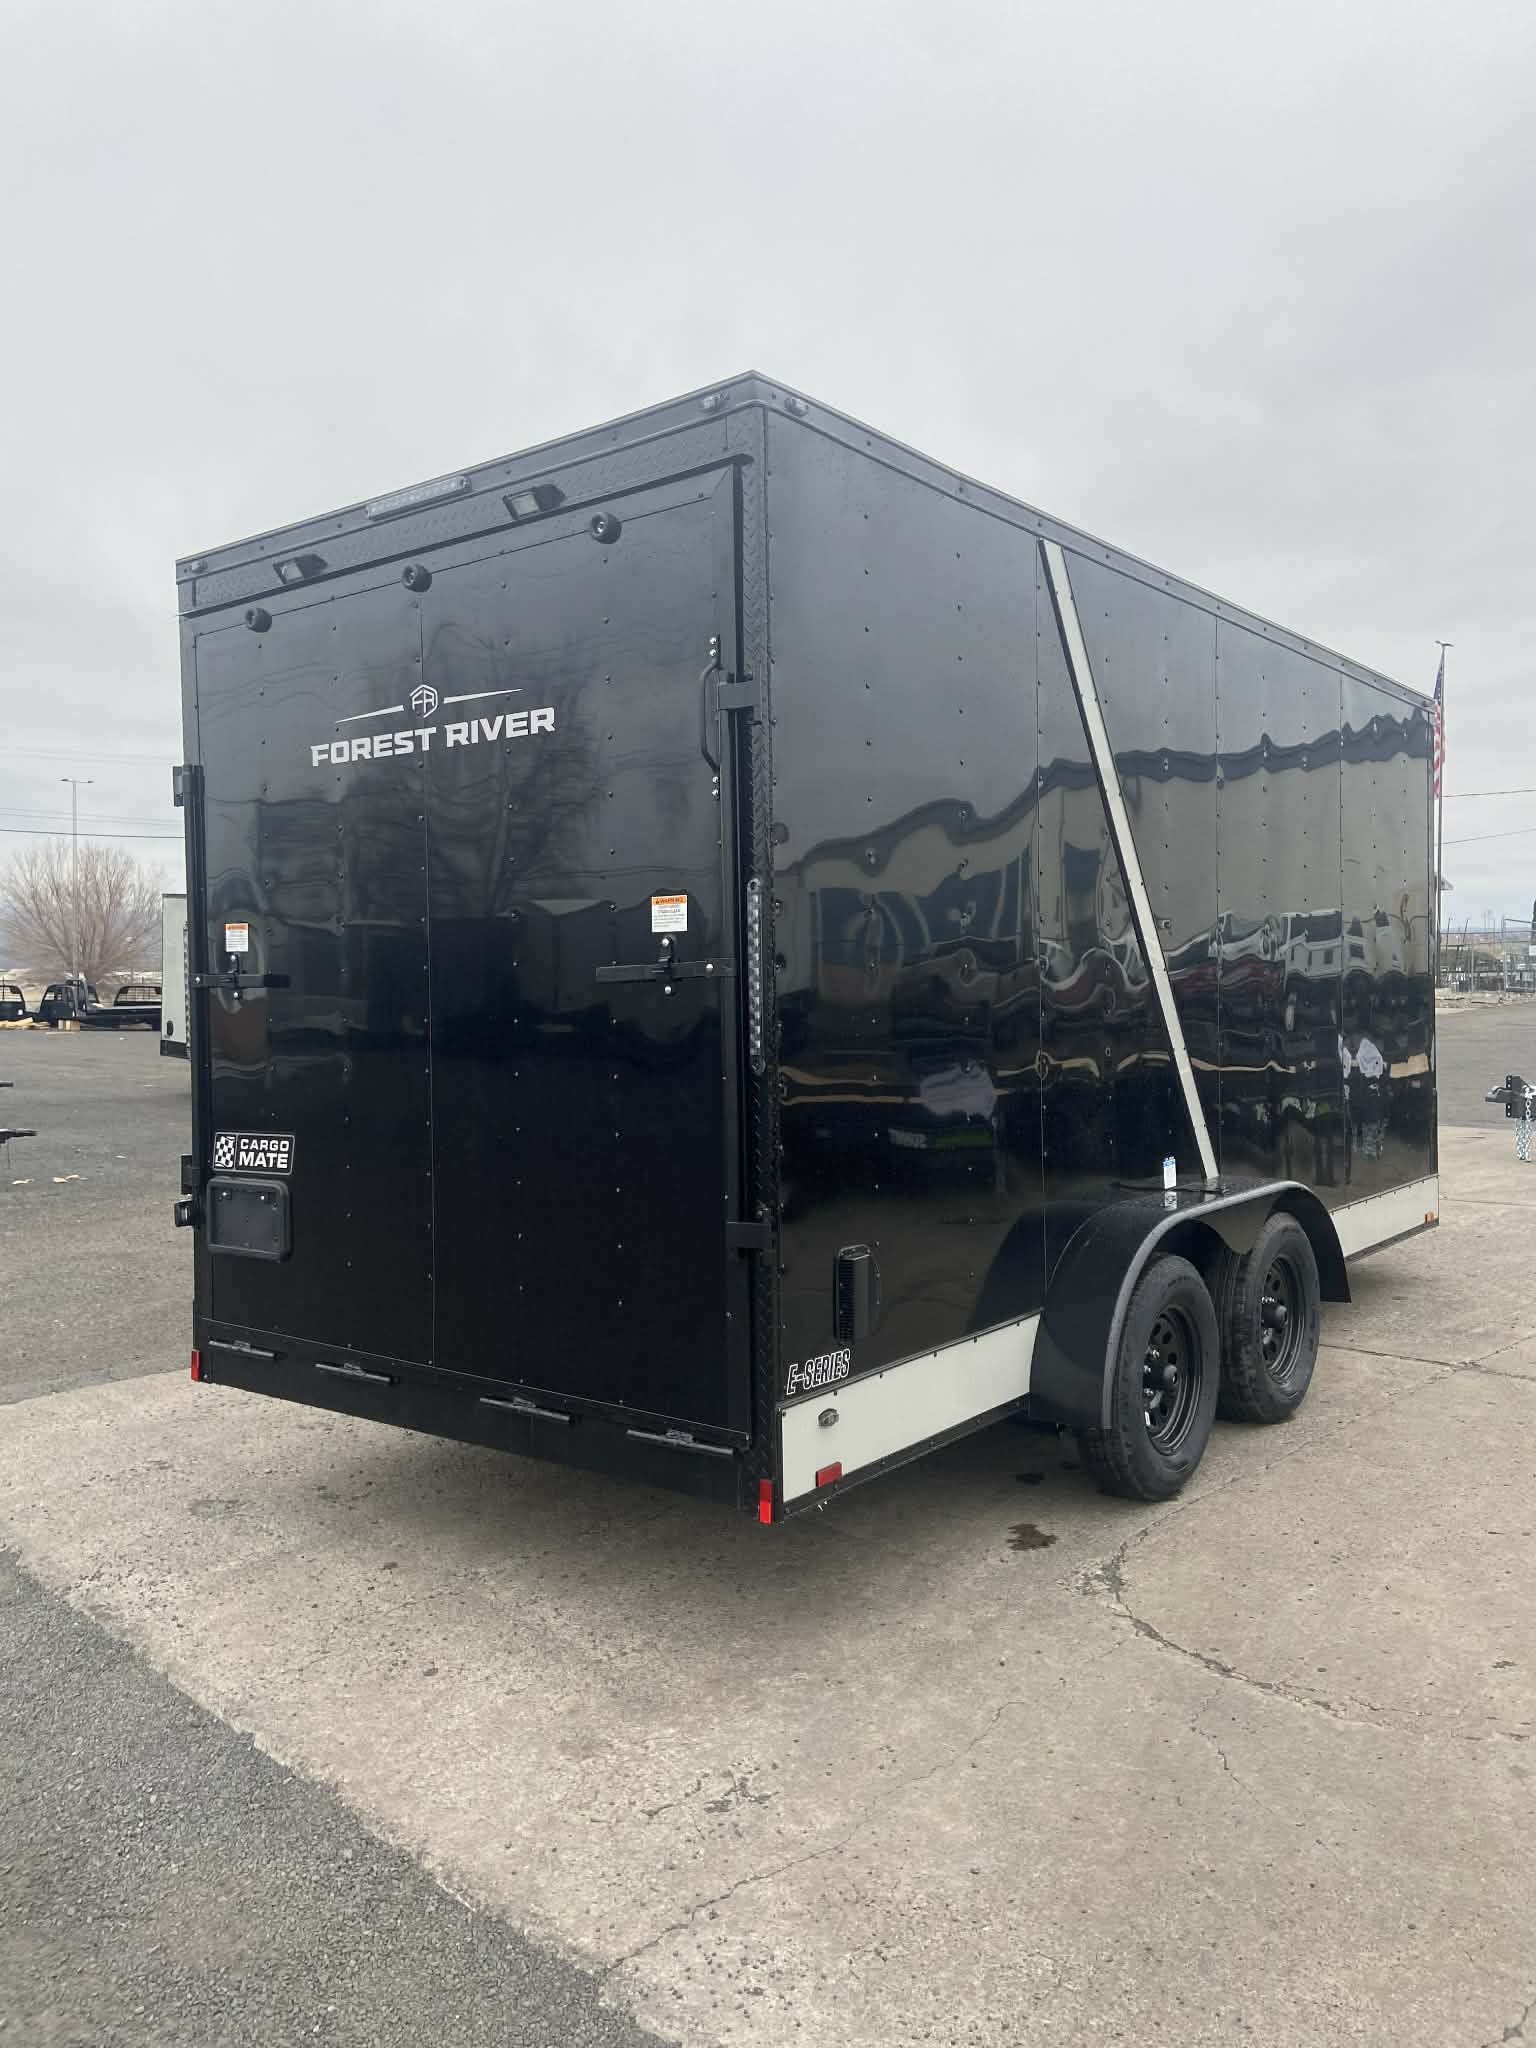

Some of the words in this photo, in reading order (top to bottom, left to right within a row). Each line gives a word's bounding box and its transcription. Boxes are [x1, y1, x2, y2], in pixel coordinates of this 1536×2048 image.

[310, 727, 436, 766] FOREST
[445, 707, 556, 747] RIVER
[239, 1151, 289, 1169] MATE
[240, 1138, 289, 1152] CARGO
[786, 1348, 851, 1395] E-SERIES
